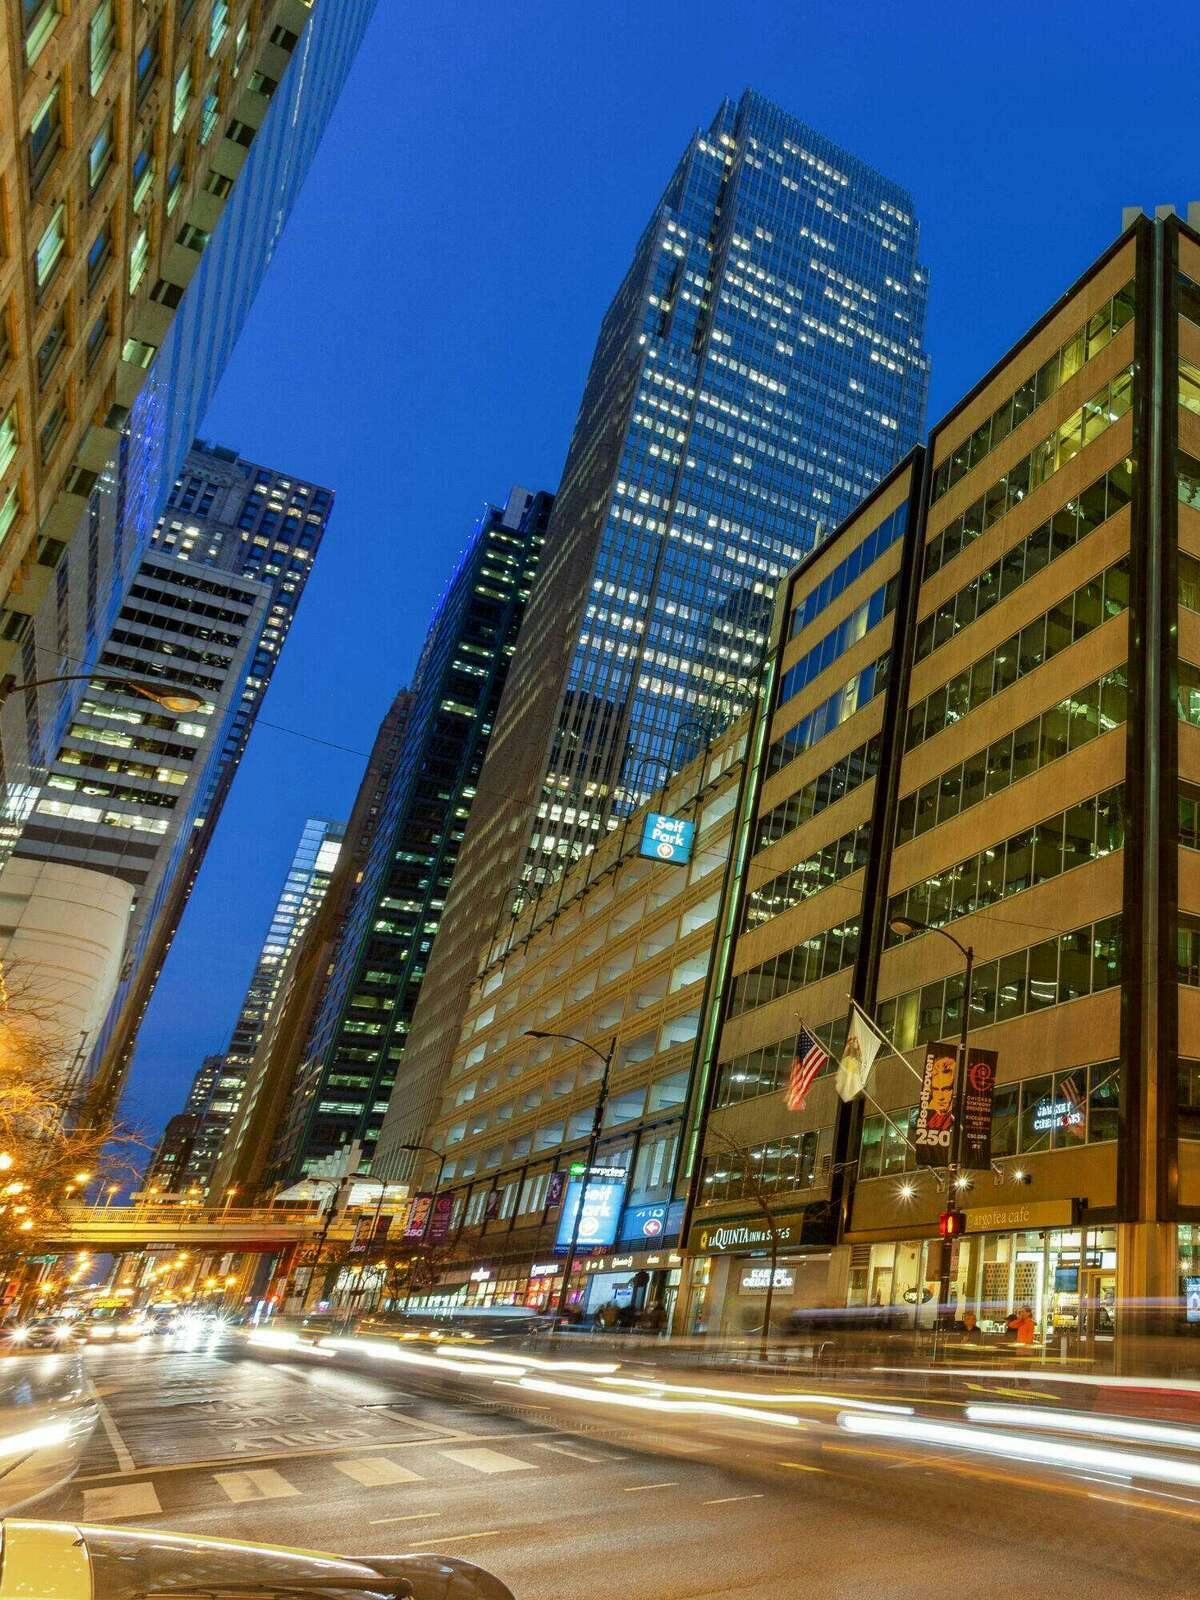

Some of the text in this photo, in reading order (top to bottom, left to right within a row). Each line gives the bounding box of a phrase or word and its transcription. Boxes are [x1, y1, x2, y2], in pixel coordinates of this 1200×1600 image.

[655, 816, 686, 833] Self
[652, 828, 685, 846] Park
[917, 1054, 935, 1129] Beethoven
[915, 1129, 951, 1147] 250
[403, 1228, 423, 1237] 250
[715, 1228, 749, 1249] QUINTA
[749, 1231, 761, 1242] INN
[208, 1413, 317, 1434] BUS
[231, 1429, 373, 1452] ONLY
